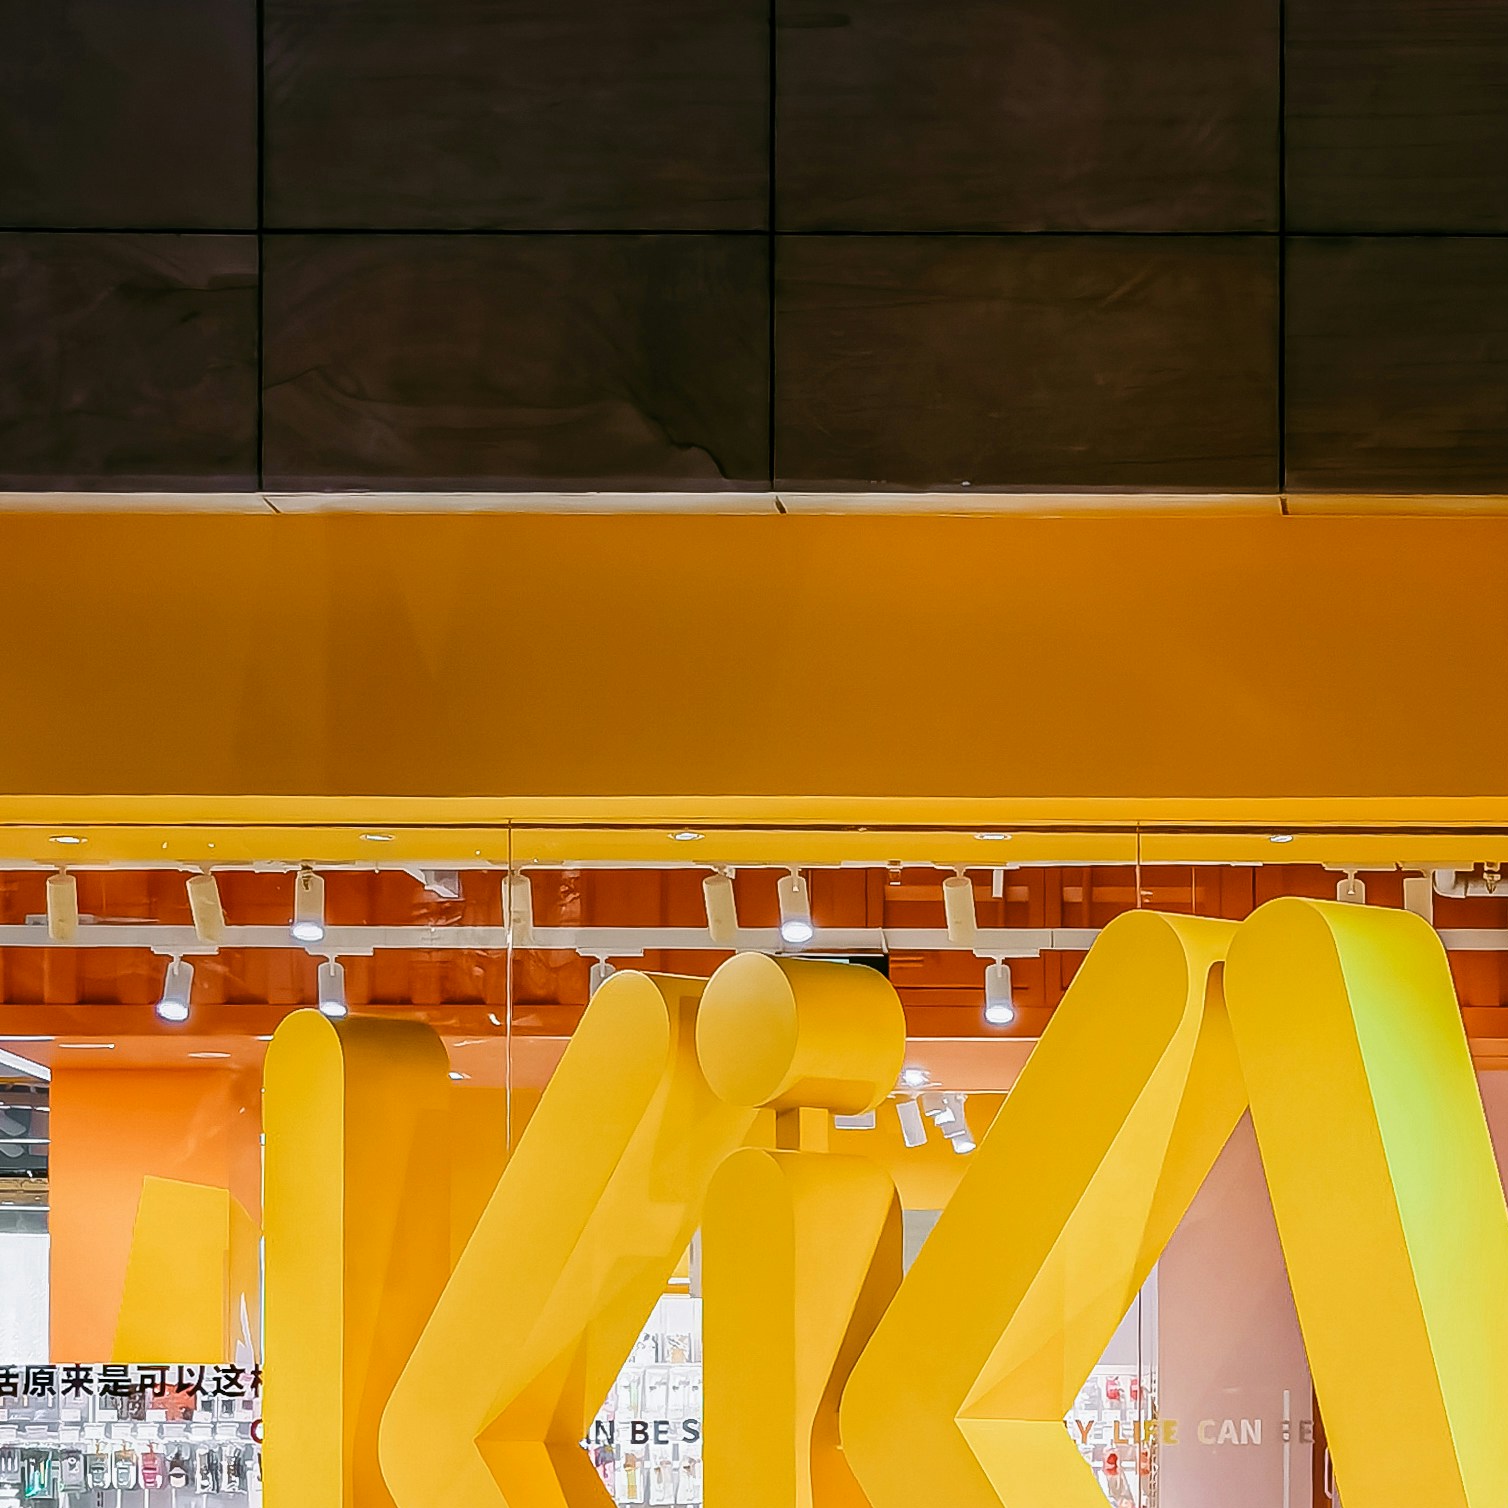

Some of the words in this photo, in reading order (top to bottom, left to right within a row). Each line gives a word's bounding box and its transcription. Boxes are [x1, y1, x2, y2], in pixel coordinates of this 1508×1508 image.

[631, 1420, 669, 1445] BE
[1070, 1419, 1095, 1444] Y
[1113, 1419, 1179, 1445] LIFE
[1197, 1419, 1262, 1445] CAN
